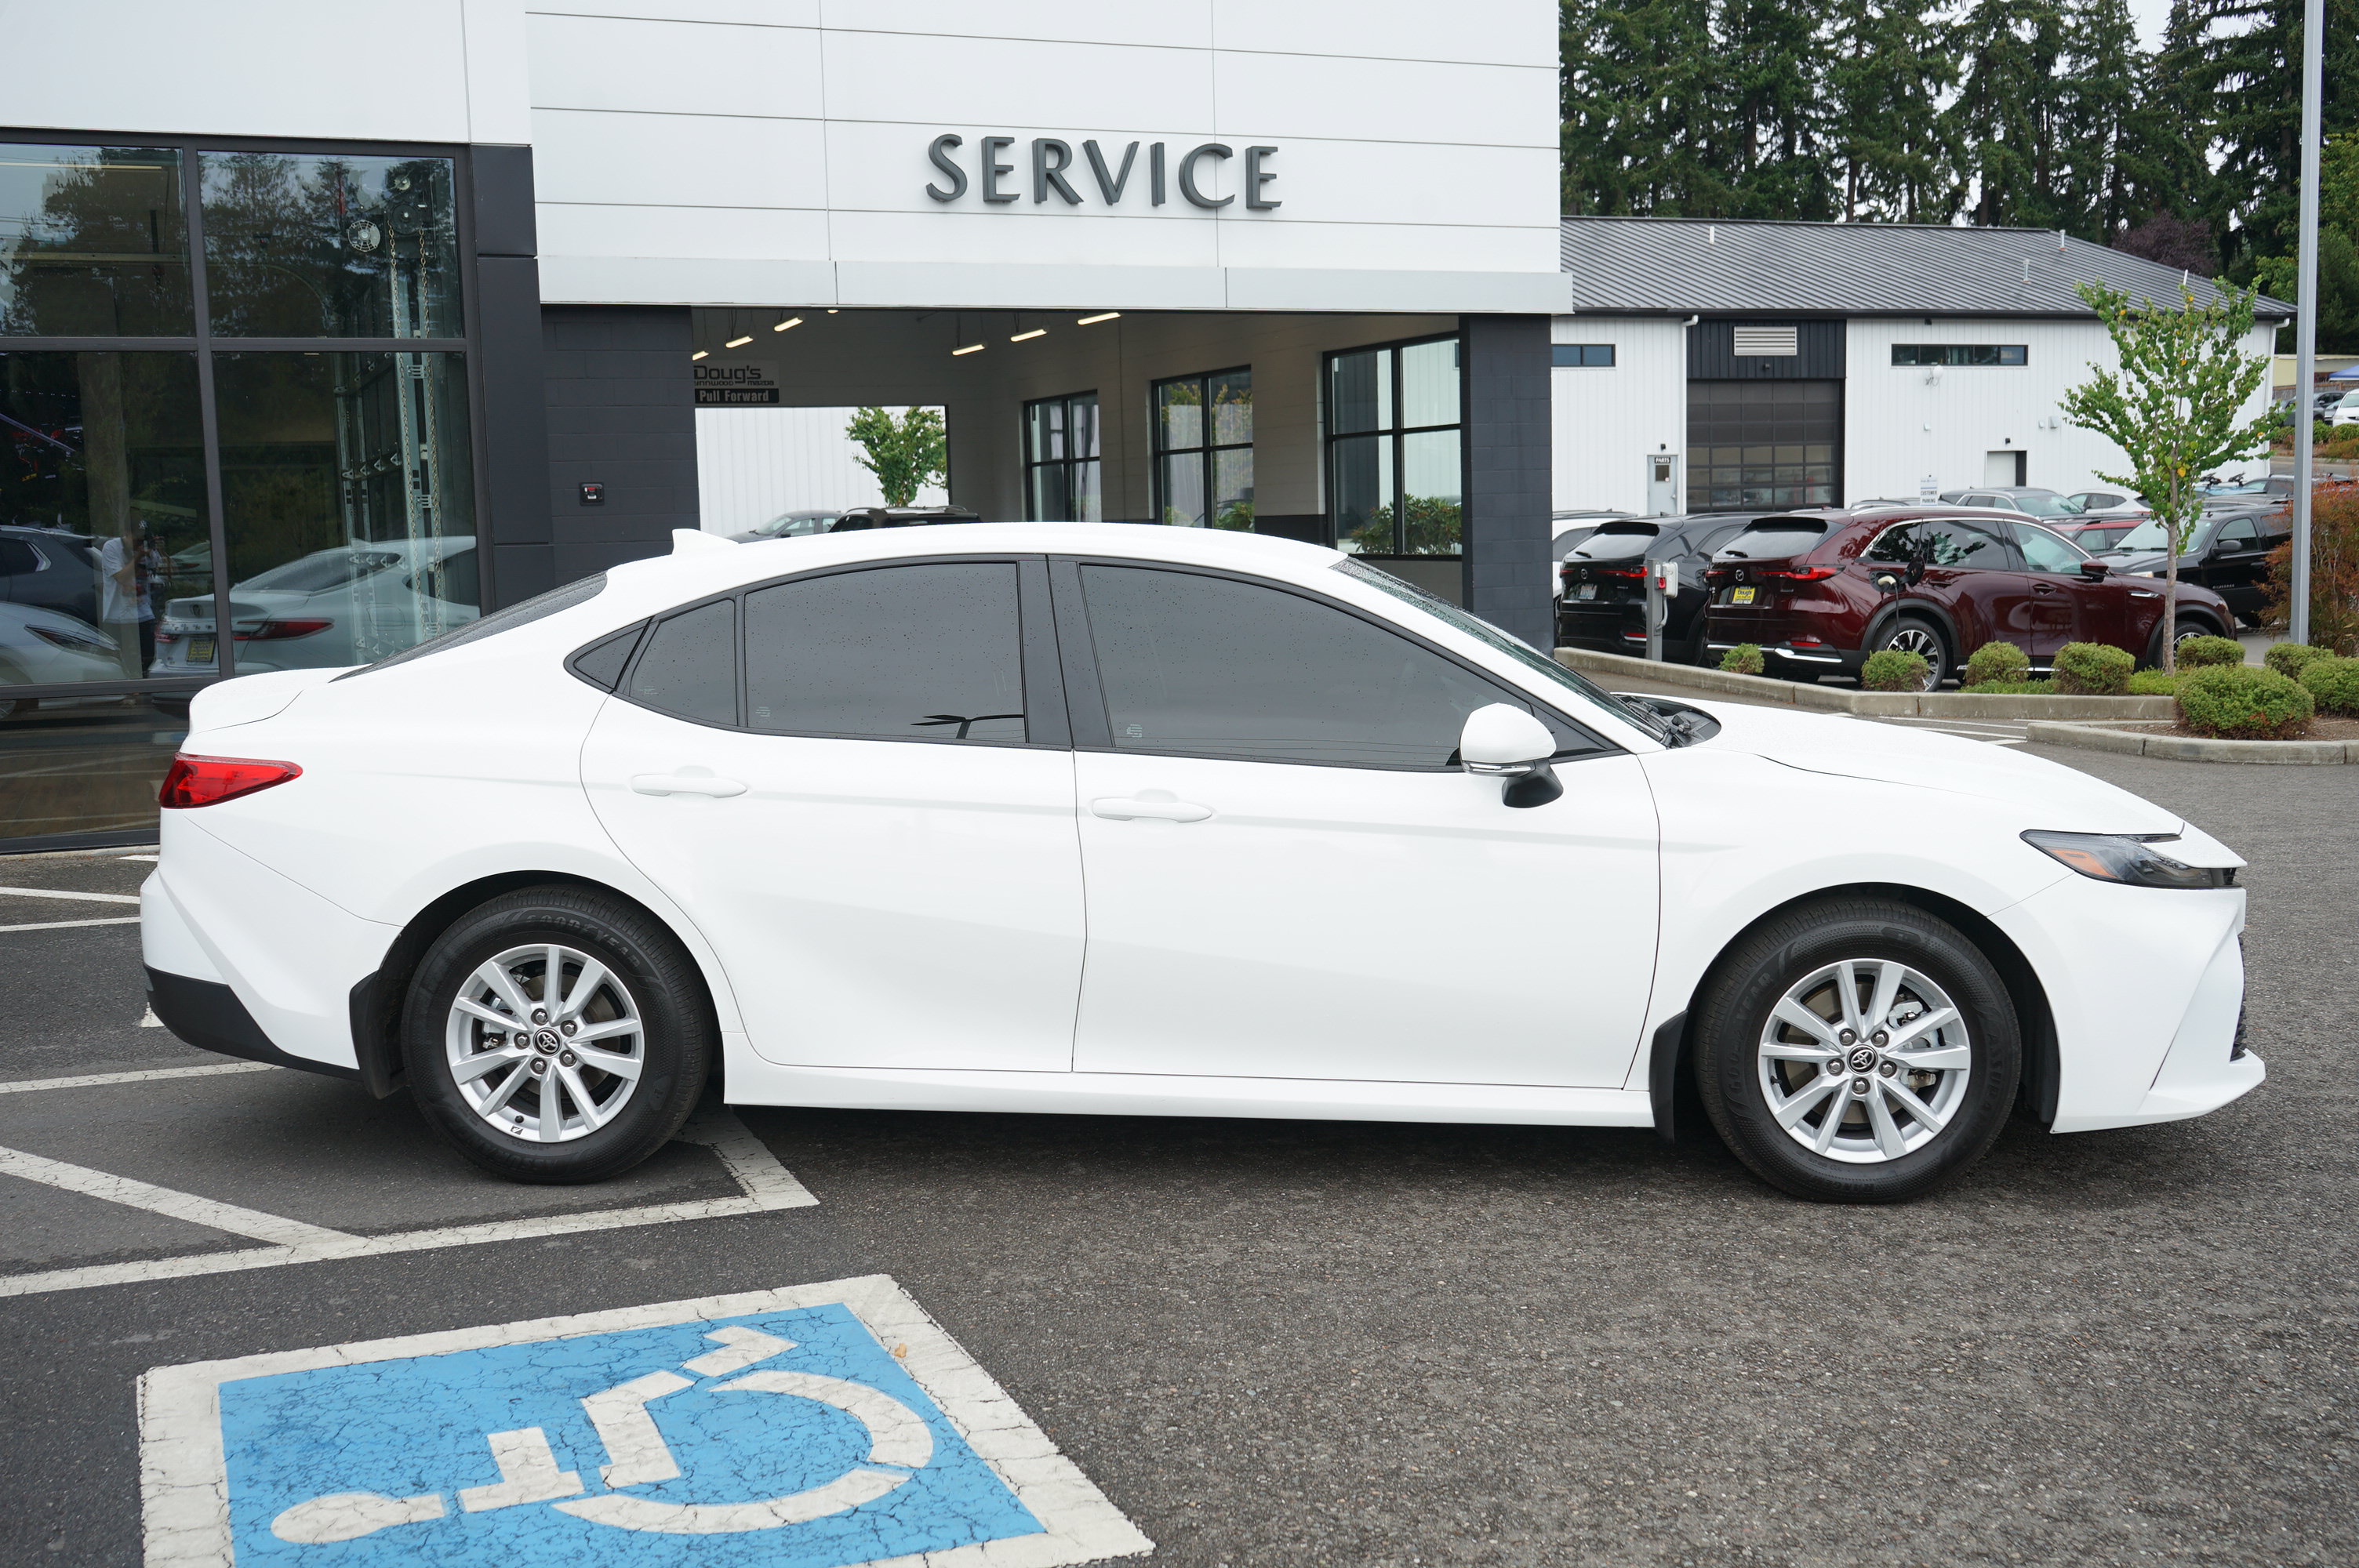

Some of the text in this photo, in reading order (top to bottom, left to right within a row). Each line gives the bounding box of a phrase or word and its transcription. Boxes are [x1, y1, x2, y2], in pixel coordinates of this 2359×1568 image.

[926, 133, 1283, 211] SERVICE
[694, 365, 761, 383] Doug's
[700, 390, 769, 402] Pull Forward
